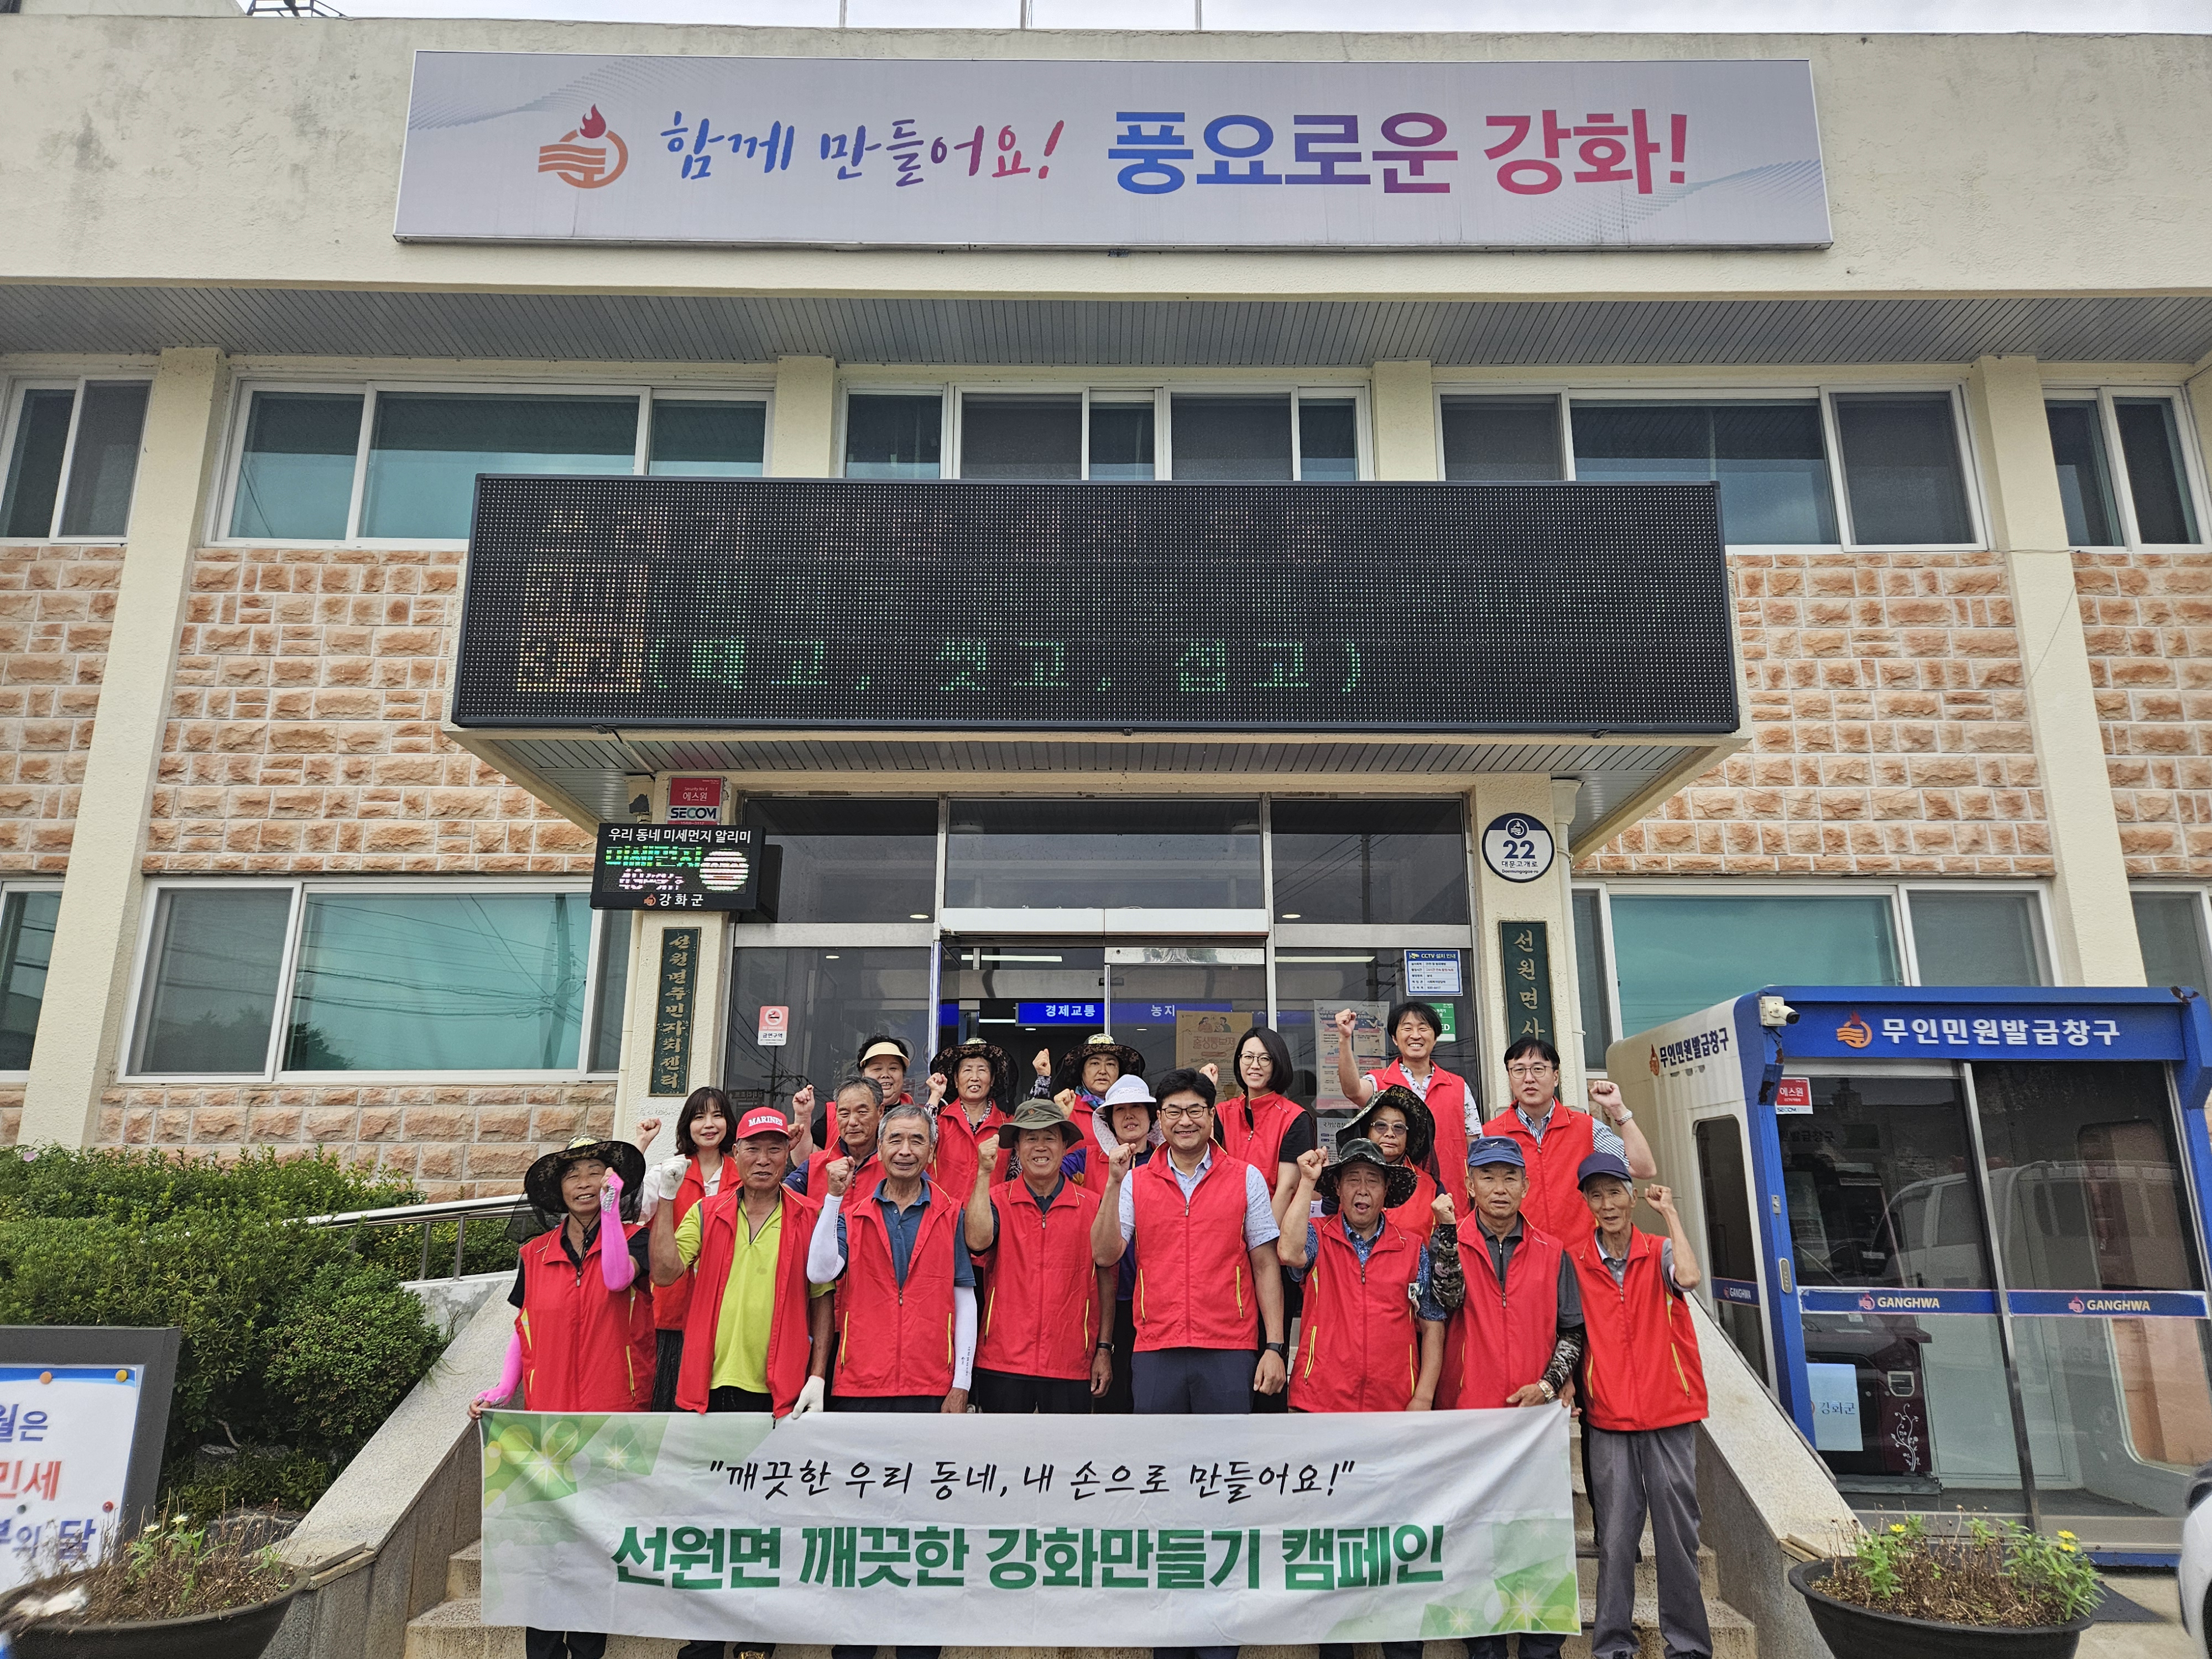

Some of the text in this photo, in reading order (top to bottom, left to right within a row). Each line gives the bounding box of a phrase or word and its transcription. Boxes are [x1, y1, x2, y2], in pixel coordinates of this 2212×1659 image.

[661, 108, 1687, 195] 함께 만들어요! 풍요로운 강화!
[683, 792, 707, 801] 에스원
[671, 807, 717, 819] SECOM
[609, 828, 751, 843] 우리 동네 미세먼지 알리미
[1503, 840, 1536, 859] 22
[659, 894, 703, 906] 강화군
[660, 935, 690, 1089] 선원면주민자치센터
[1046, 1005, 1095, 1017] 경제교통
[1151, 1005, 1175, 1017] 농지
[1881, 1019, 2120, 1046] 무인민원발급창구
[1660, 1027, 1729, 1067] 무인민원발급창구
[1780, 1087, 1804, 1097] 에스원
[748, 1116, 783, 1127] MARINES
[1730, 1287, 1751, 1300] GANGHWA
[1877, 1296, 1940, 1309] GANGHWA
[2086, 1300, 2151, 1311] GANGHWA
[1819, 1401, 1855, 1415] 강화군
[710, 1459, 1355, 1504] "깨끗한 우리 동네, 내 손으로 만들어요!"
[611, 1525, 1444, 1590] 선원면 깨끗한 강화만들기 캠페인
